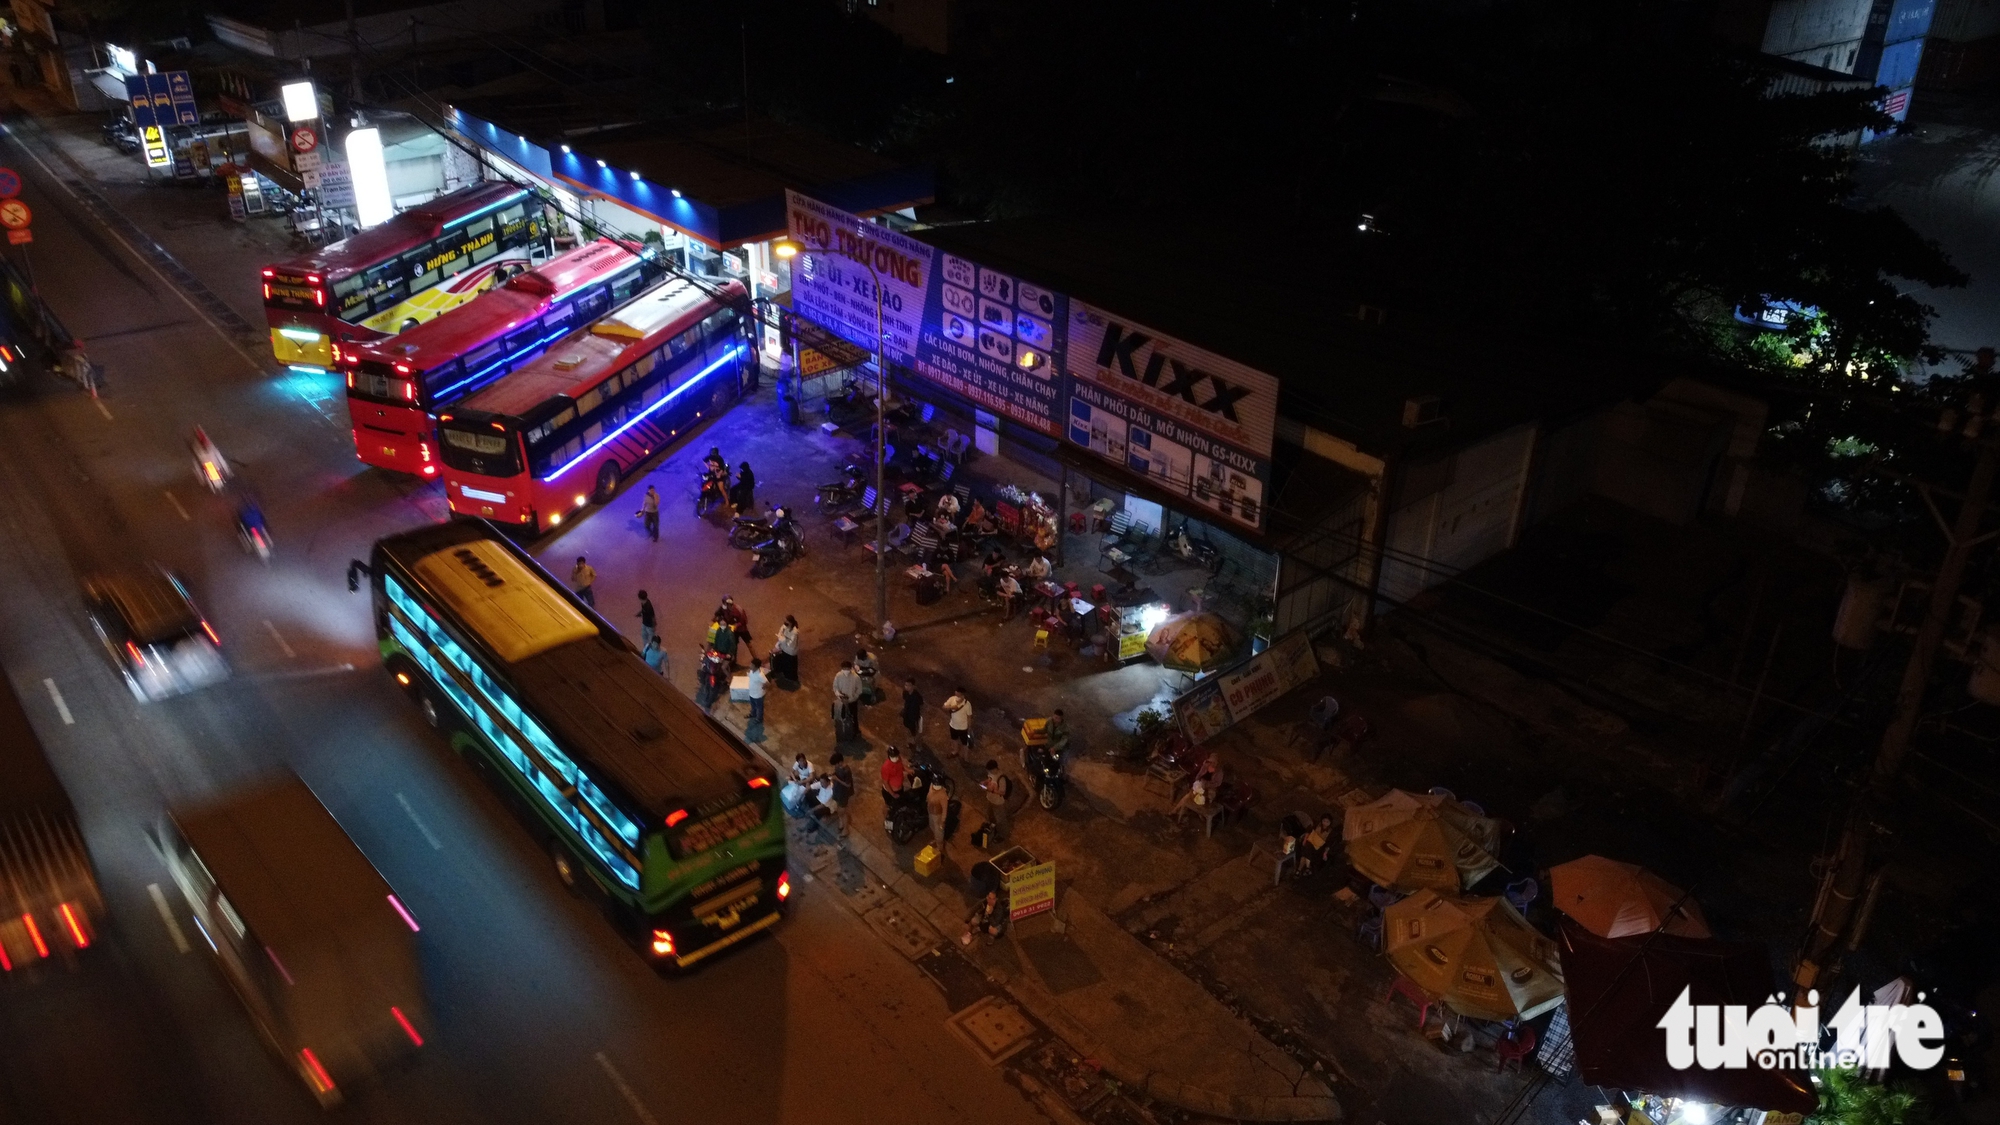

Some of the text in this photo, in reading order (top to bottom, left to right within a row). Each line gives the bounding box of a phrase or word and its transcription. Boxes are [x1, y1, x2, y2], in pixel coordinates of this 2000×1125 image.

[853, 274, 869, 299] XE
[923, 332, 1057, 401] CÁC LOẠI BƠM, NHÔNG, CHÂN CHẠY
[931, 353, 941, 366] XE
[941, 357, 958, 374] ĐÀO
[962, 367, 972, 382] XE
[973, 369, 982, 386] ỦI
[987, 379, 997, 393] XE
[998, 384, 1009, 397] LU
[1014, 391, 1024, 405] XE
[1075, 383, 1257, 475] PHÂN PHỐI DẦU, MỠ NHỜN GS-KIXX
